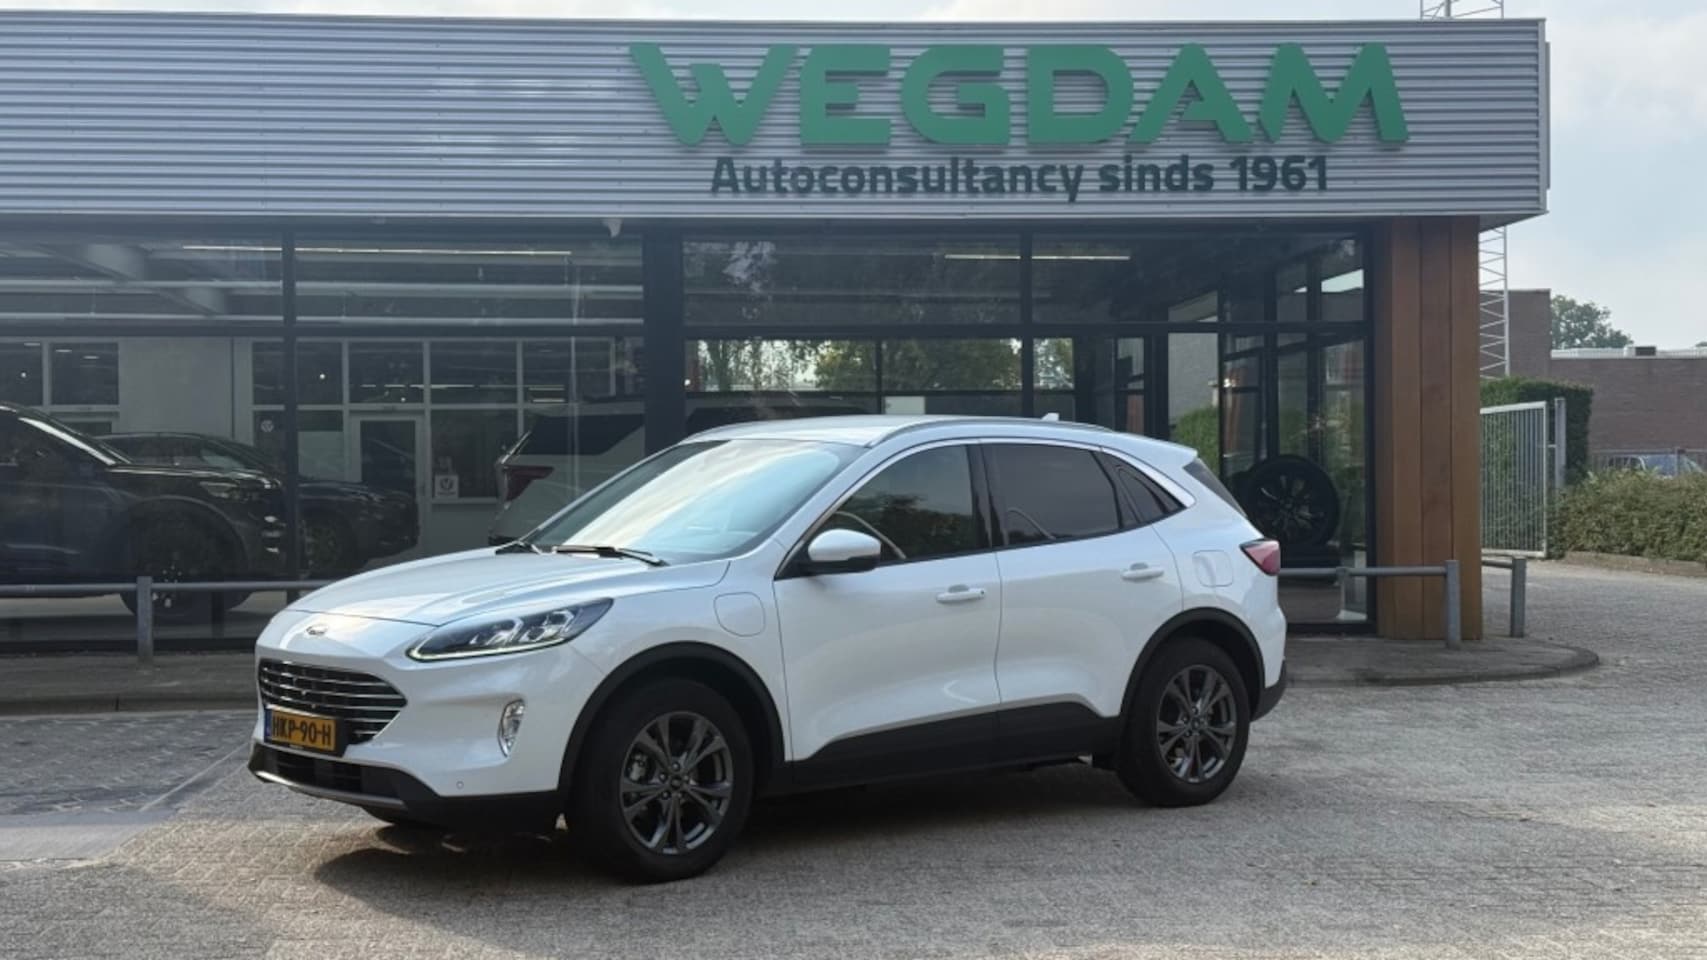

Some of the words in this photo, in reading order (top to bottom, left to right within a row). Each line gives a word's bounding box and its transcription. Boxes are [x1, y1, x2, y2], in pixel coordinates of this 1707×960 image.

[629, 43, 1409, 146] WEGDAM
[711, 156, 1084, 202] Autoconsultancy
[1098, 154, 1214, 192] sinds
[1229, 155, 1327, 191] 1961
[272, 714, 332, 747] HKP-90-H
